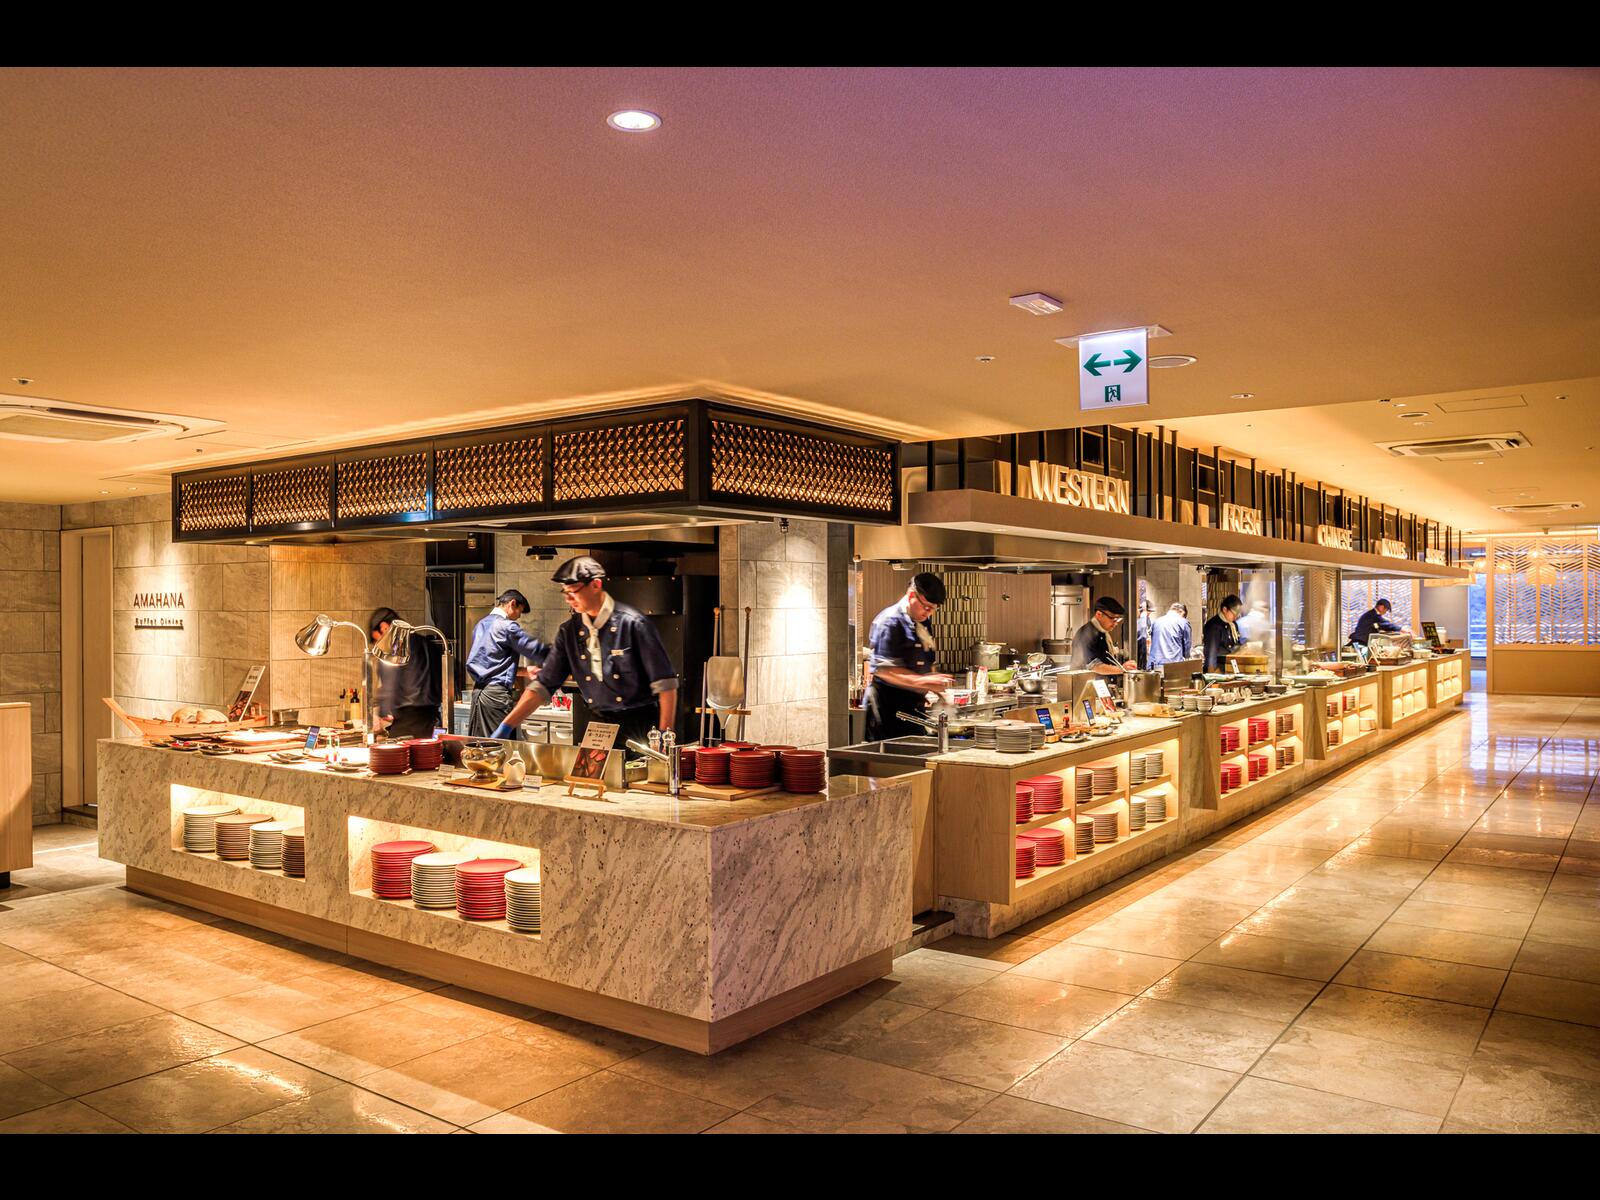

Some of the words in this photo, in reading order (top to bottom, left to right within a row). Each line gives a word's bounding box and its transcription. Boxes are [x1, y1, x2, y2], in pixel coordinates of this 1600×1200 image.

[1029, 460, 1130, 515] WESTERN
[1222, 502, 1262, 536] FRESH
[1317, 524, 1353, 551] CHINESE
[133, 592, 185, 609] AMAHANA
[135, 617, 157, 626] Buffet
[160, 617, 184, 626] Dining
